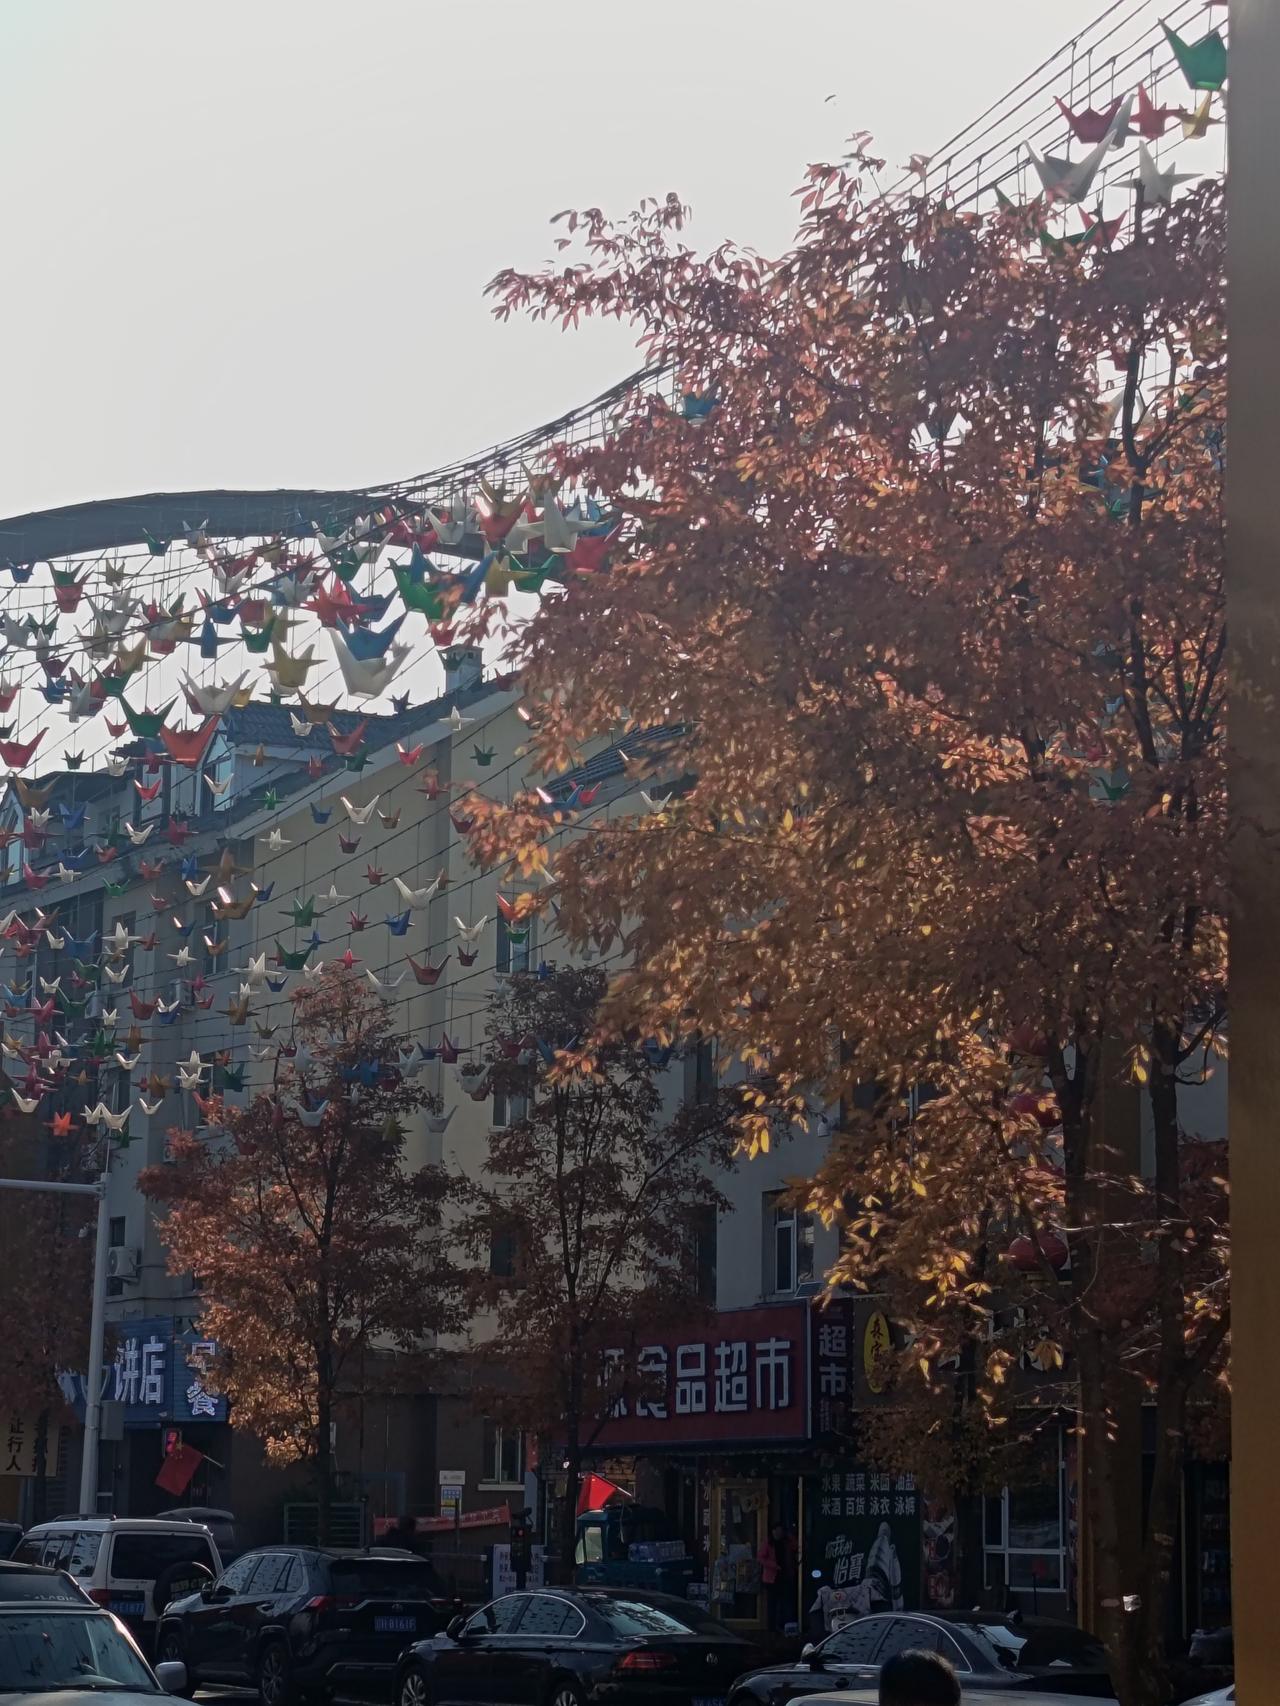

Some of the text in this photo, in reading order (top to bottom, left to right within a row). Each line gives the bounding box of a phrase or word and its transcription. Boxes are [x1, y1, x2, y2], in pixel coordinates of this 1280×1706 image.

[818, 1303, 848, 1397] 超市
[845, 1497, 865, 1516] 百货
[870, 1497, 890, 1516] 泳衣
